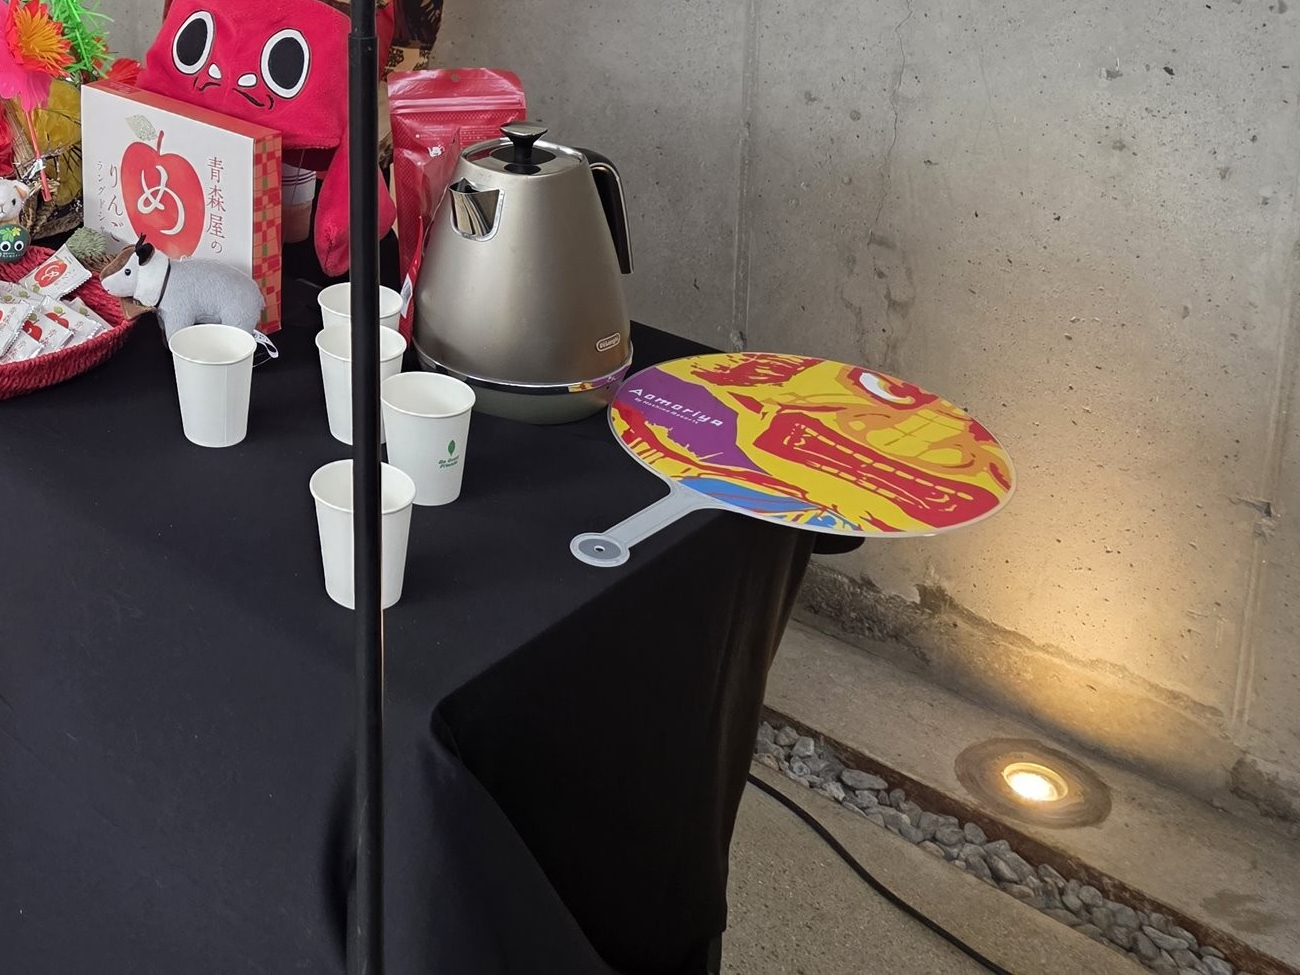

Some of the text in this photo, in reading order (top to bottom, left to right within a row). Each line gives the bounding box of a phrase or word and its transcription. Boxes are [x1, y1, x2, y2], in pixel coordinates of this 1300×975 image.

[137, 165, 185, 236] め
[207, 156, 226, 254] 青森屋の
[628, 388, 724, 427] Aomoriya
